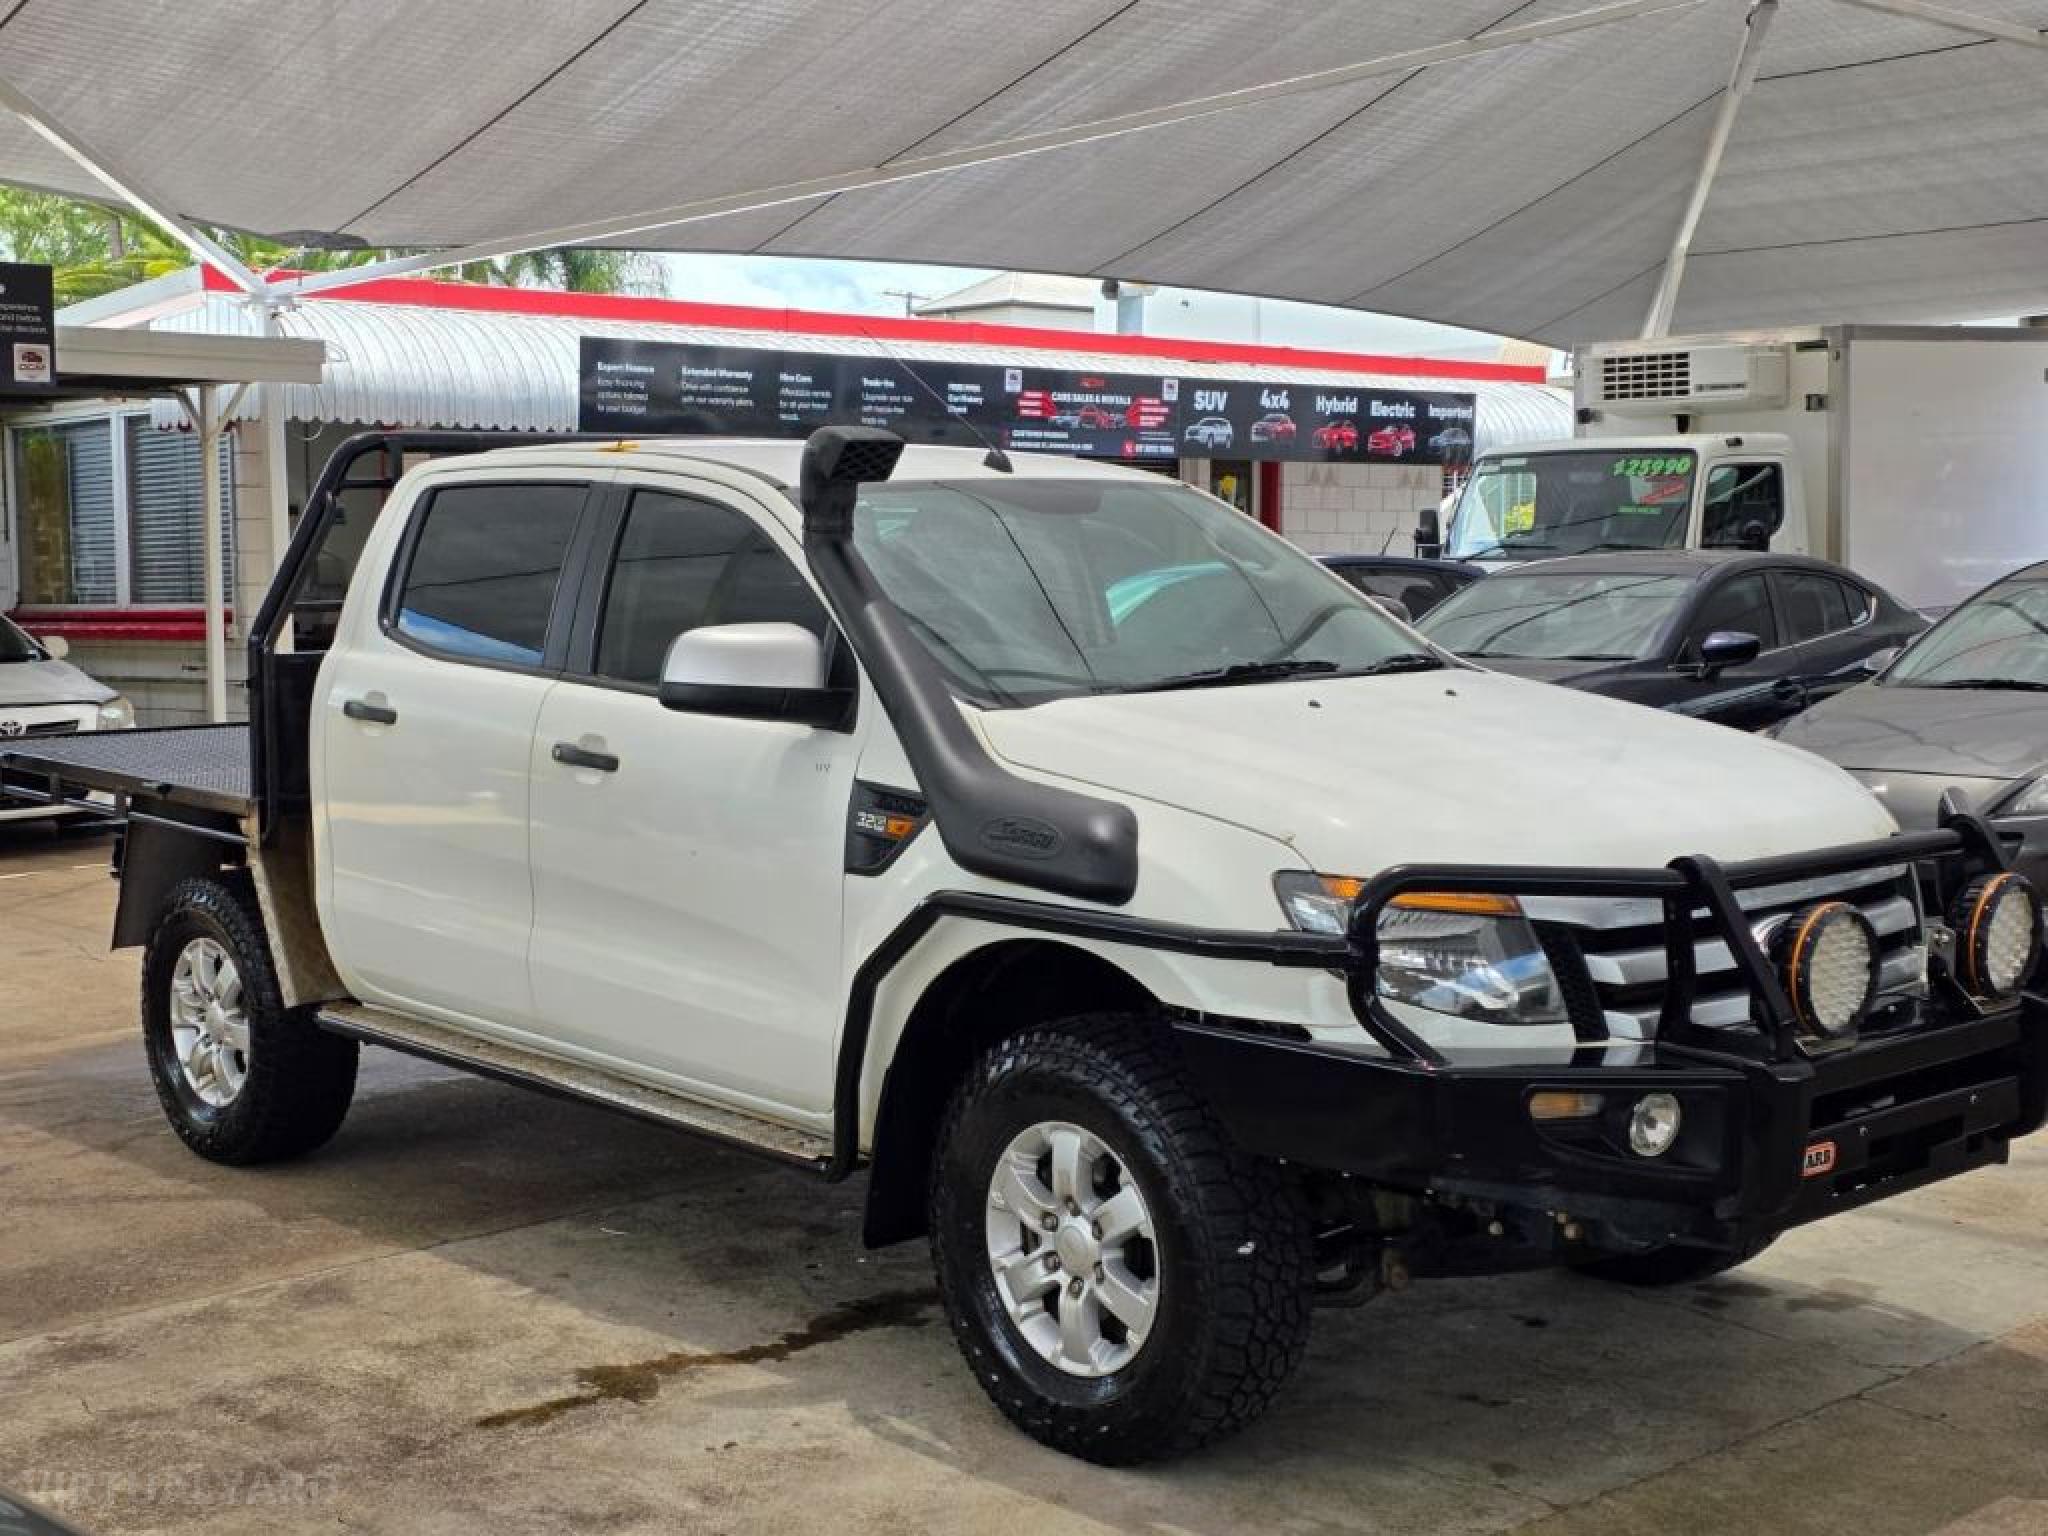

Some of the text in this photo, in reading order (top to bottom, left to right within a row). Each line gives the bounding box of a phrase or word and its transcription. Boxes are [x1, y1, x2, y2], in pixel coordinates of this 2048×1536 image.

[1193, 390, 1229, 411] SUV
[1260, 389, 1290, 410] 4x4
[1315, 395, 1358, 416] Hybrid
[1371, 400, 1415, 418] Electric
[1613, 455, 1690, 476] $25990
